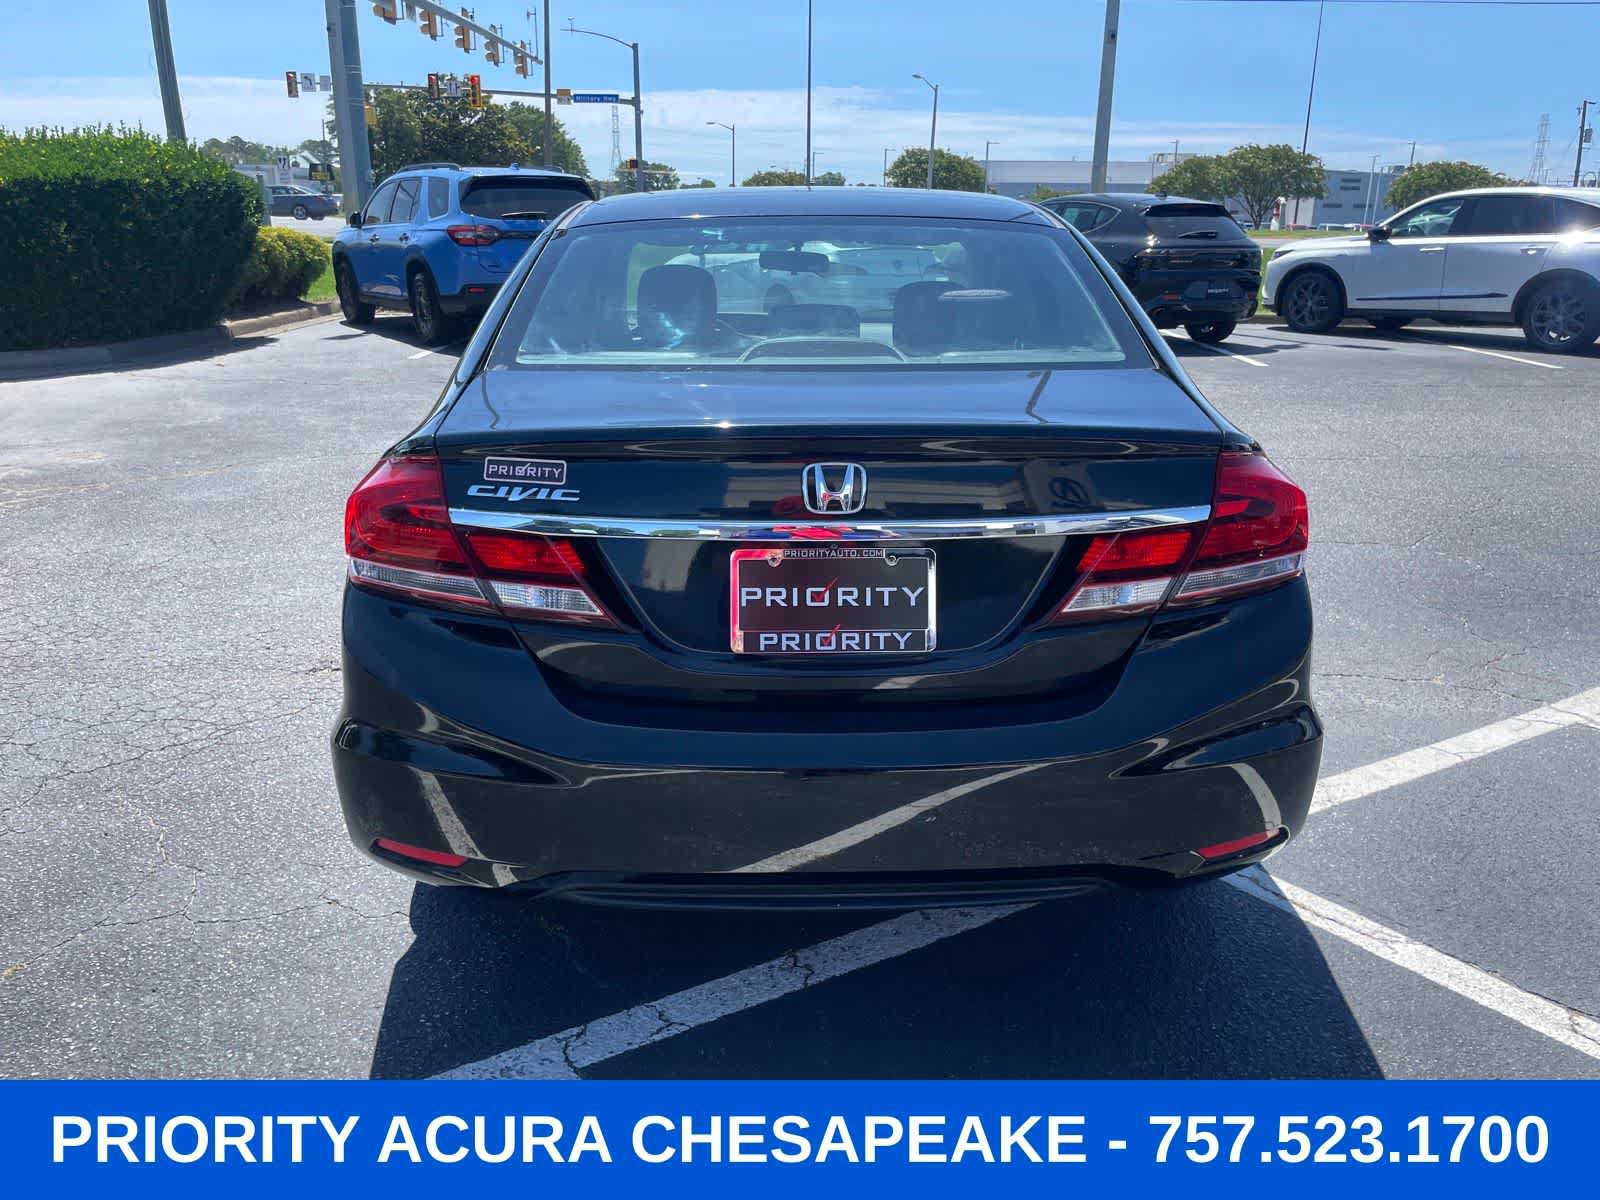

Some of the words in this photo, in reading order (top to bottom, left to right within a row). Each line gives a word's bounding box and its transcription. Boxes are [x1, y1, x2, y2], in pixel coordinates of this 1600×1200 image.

[488, 463, 562, 478] PRIORITY
[467, 484, 580, 501] CIVIC
[741, 586, 925, 607] PRIORITY
[759, 632, 912, 651] PRIORITY
